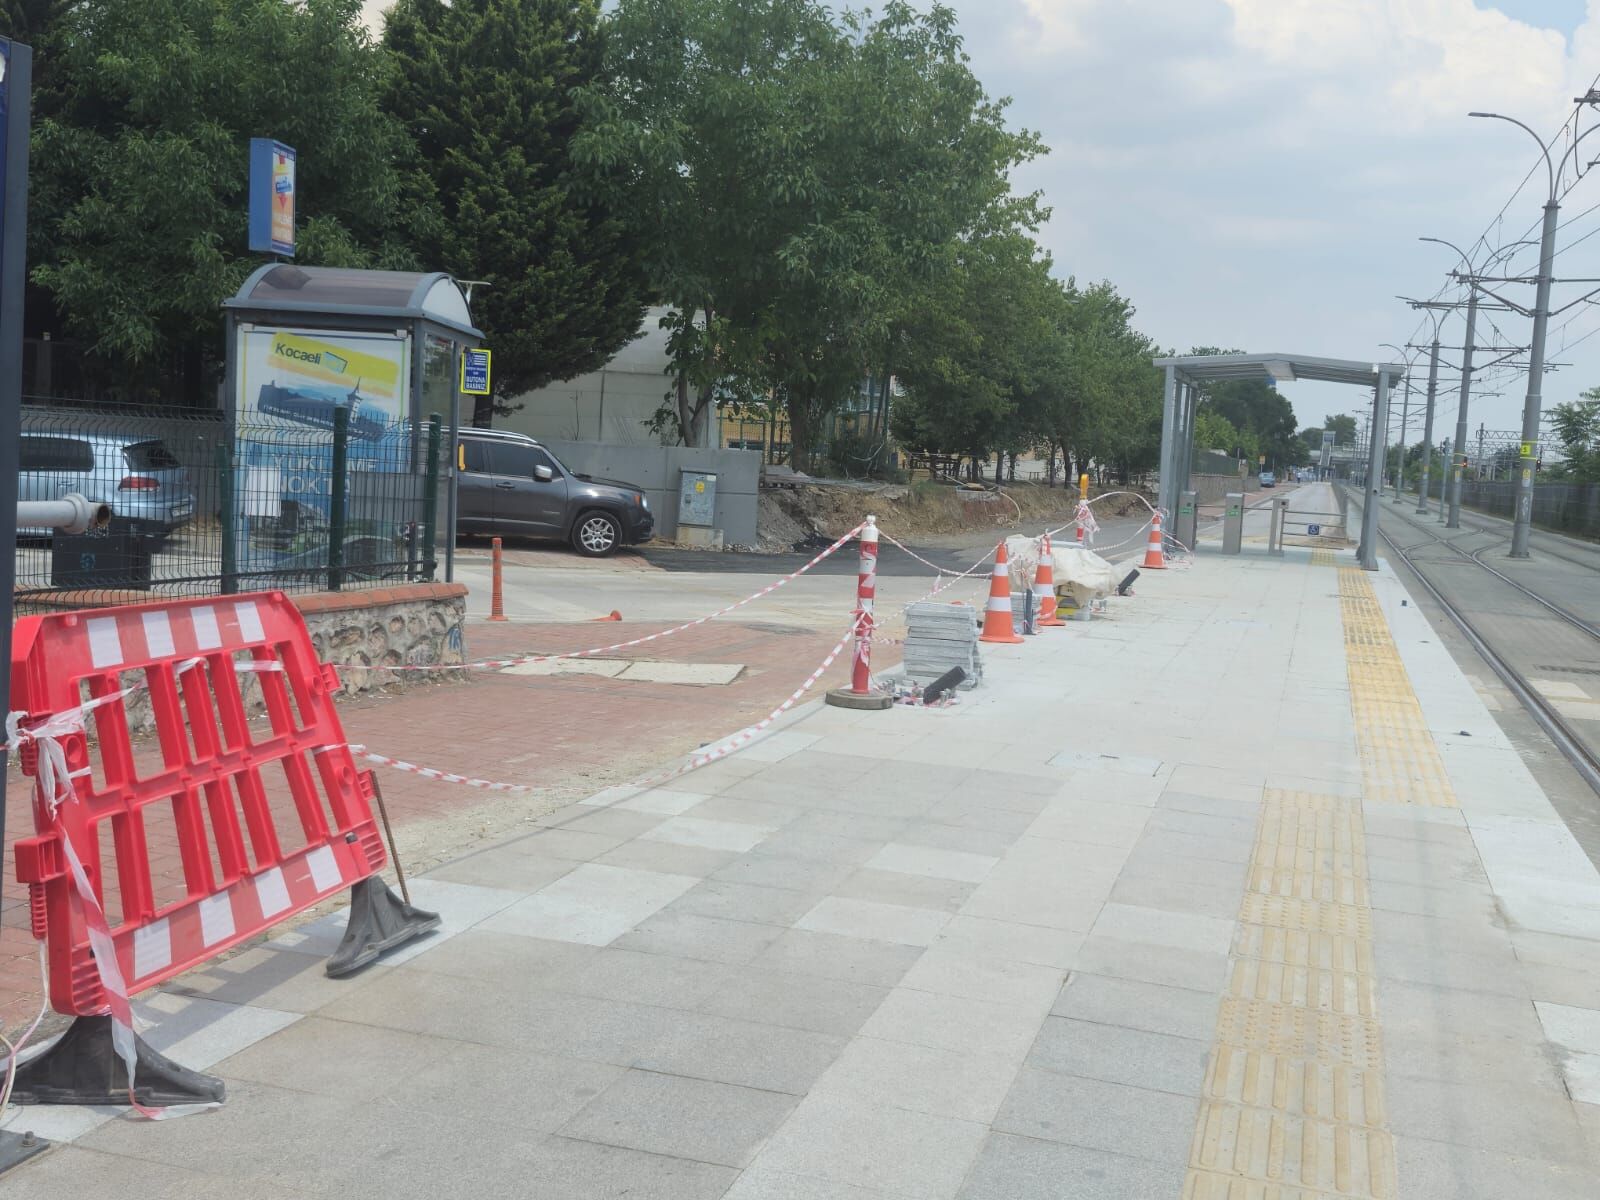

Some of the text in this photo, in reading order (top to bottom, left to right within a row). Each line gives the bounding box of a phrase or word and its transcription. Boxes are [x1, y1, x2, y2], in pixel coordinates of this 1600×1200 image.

[275, 343, 321, 365] Kocaeli
[466, 375, 485, 383] BUTONA
[272, 452, 378, 473] YÜKLME
